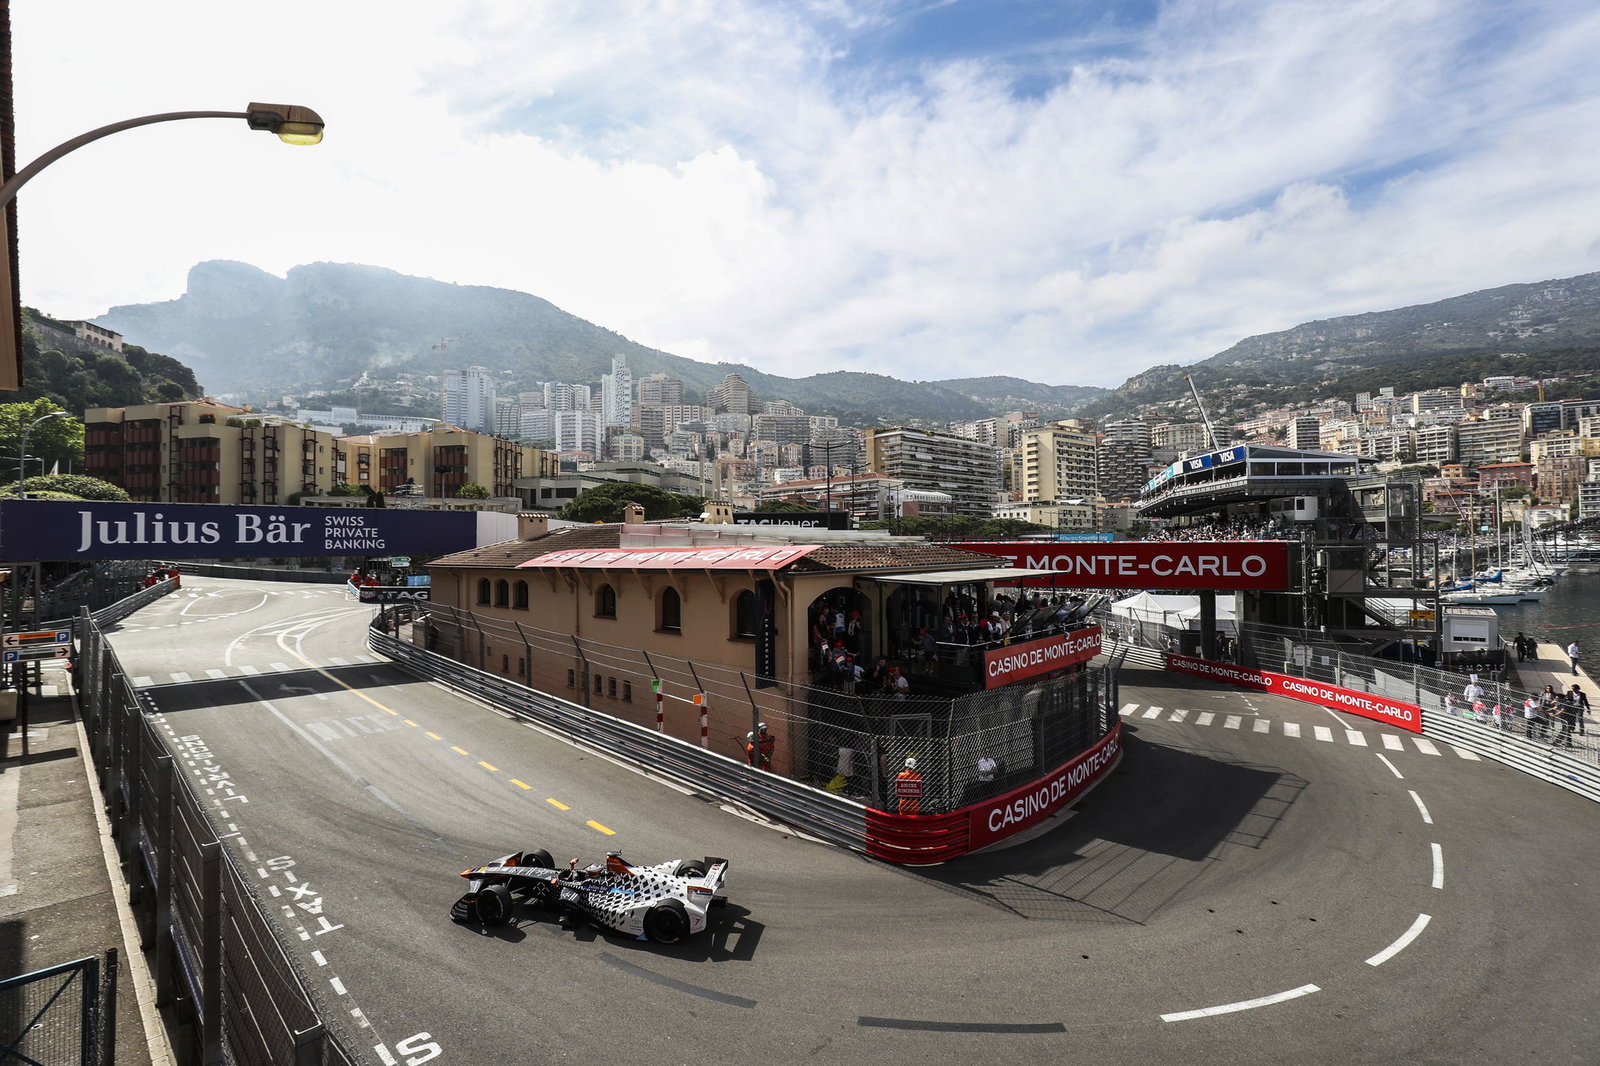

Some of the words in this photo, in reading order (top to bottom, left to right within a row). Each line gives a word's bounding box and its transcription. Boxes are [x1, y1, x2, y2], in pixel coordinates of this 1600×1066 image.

[1189, 459, 1204, 470] VISA
[1219, 450, 1235, 463] VISA
[325, 516, 364, 526] SWISS
[77, 511, 221, 552] Julius
[235, 514, 311, 544] Bär
[325, 528, 379, 538] PRIVATE
[325, 539, 386, 549] BANKING
[1026, 555, 1267, 577] MONTE-CARLO
[382, 591, 428, 600] TAG
[988, 653, 1028, 677] CASINO
[1030, 649, 1043, 666] DE
[1044, 633, 1101, 661] MONTE-CARLO
[1172, 659, 1198, 671] CASINO
[1199, 664, 1210, 673] DE
[1210, 666, 1273, 686] MONTE-CARLO
[1282, 680, 1319, 697] CASINO
[1320, 689, 1334, 701] DE
[1335, 693, 1412, 721] MONTE-CARLO
[988, 787, 1049, 832] CASINO
[1051, 775, 1067, 802] DE
[266, 855, 345, 936] TAXIS
[695, 918, 701, 926] 7
